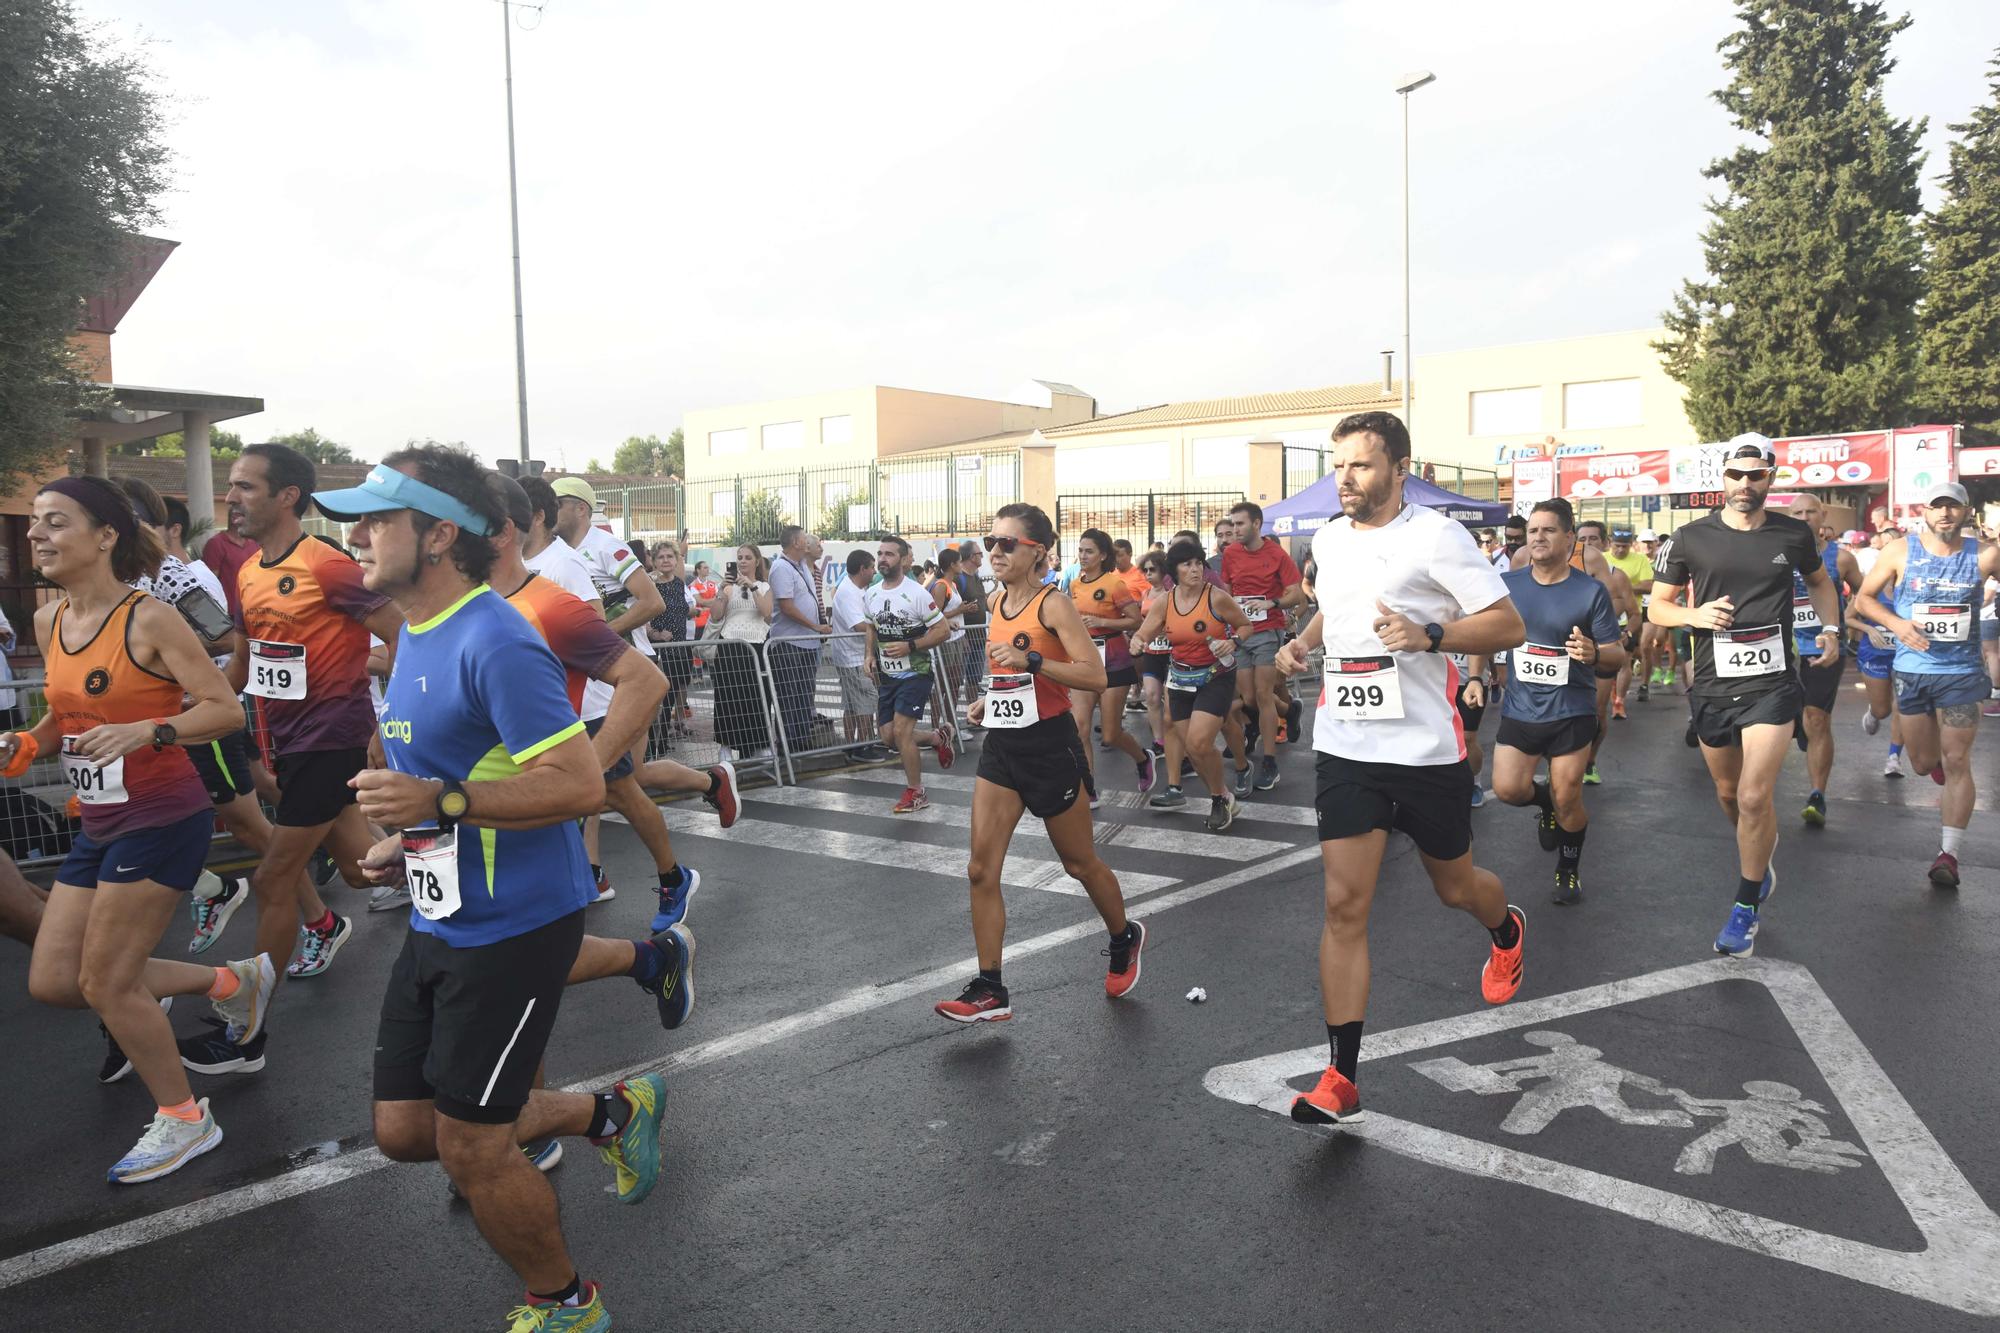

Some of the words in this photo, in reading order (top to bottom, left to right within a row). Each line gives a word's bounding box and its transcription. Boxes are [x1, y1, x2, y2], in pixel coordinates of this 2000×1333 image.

[1924, 621, 1958, 634] 081
[884, 661, 903, 670] 011
[1728, 648, 1772, 668] 420
[257, 666, 292, 688] 519
[1522, 661, 1558, 677] 366
[1337, 685, 1384, 707] 299
[991, 699, 1024, 718] 239
[69, 767, 105, 790] 301
